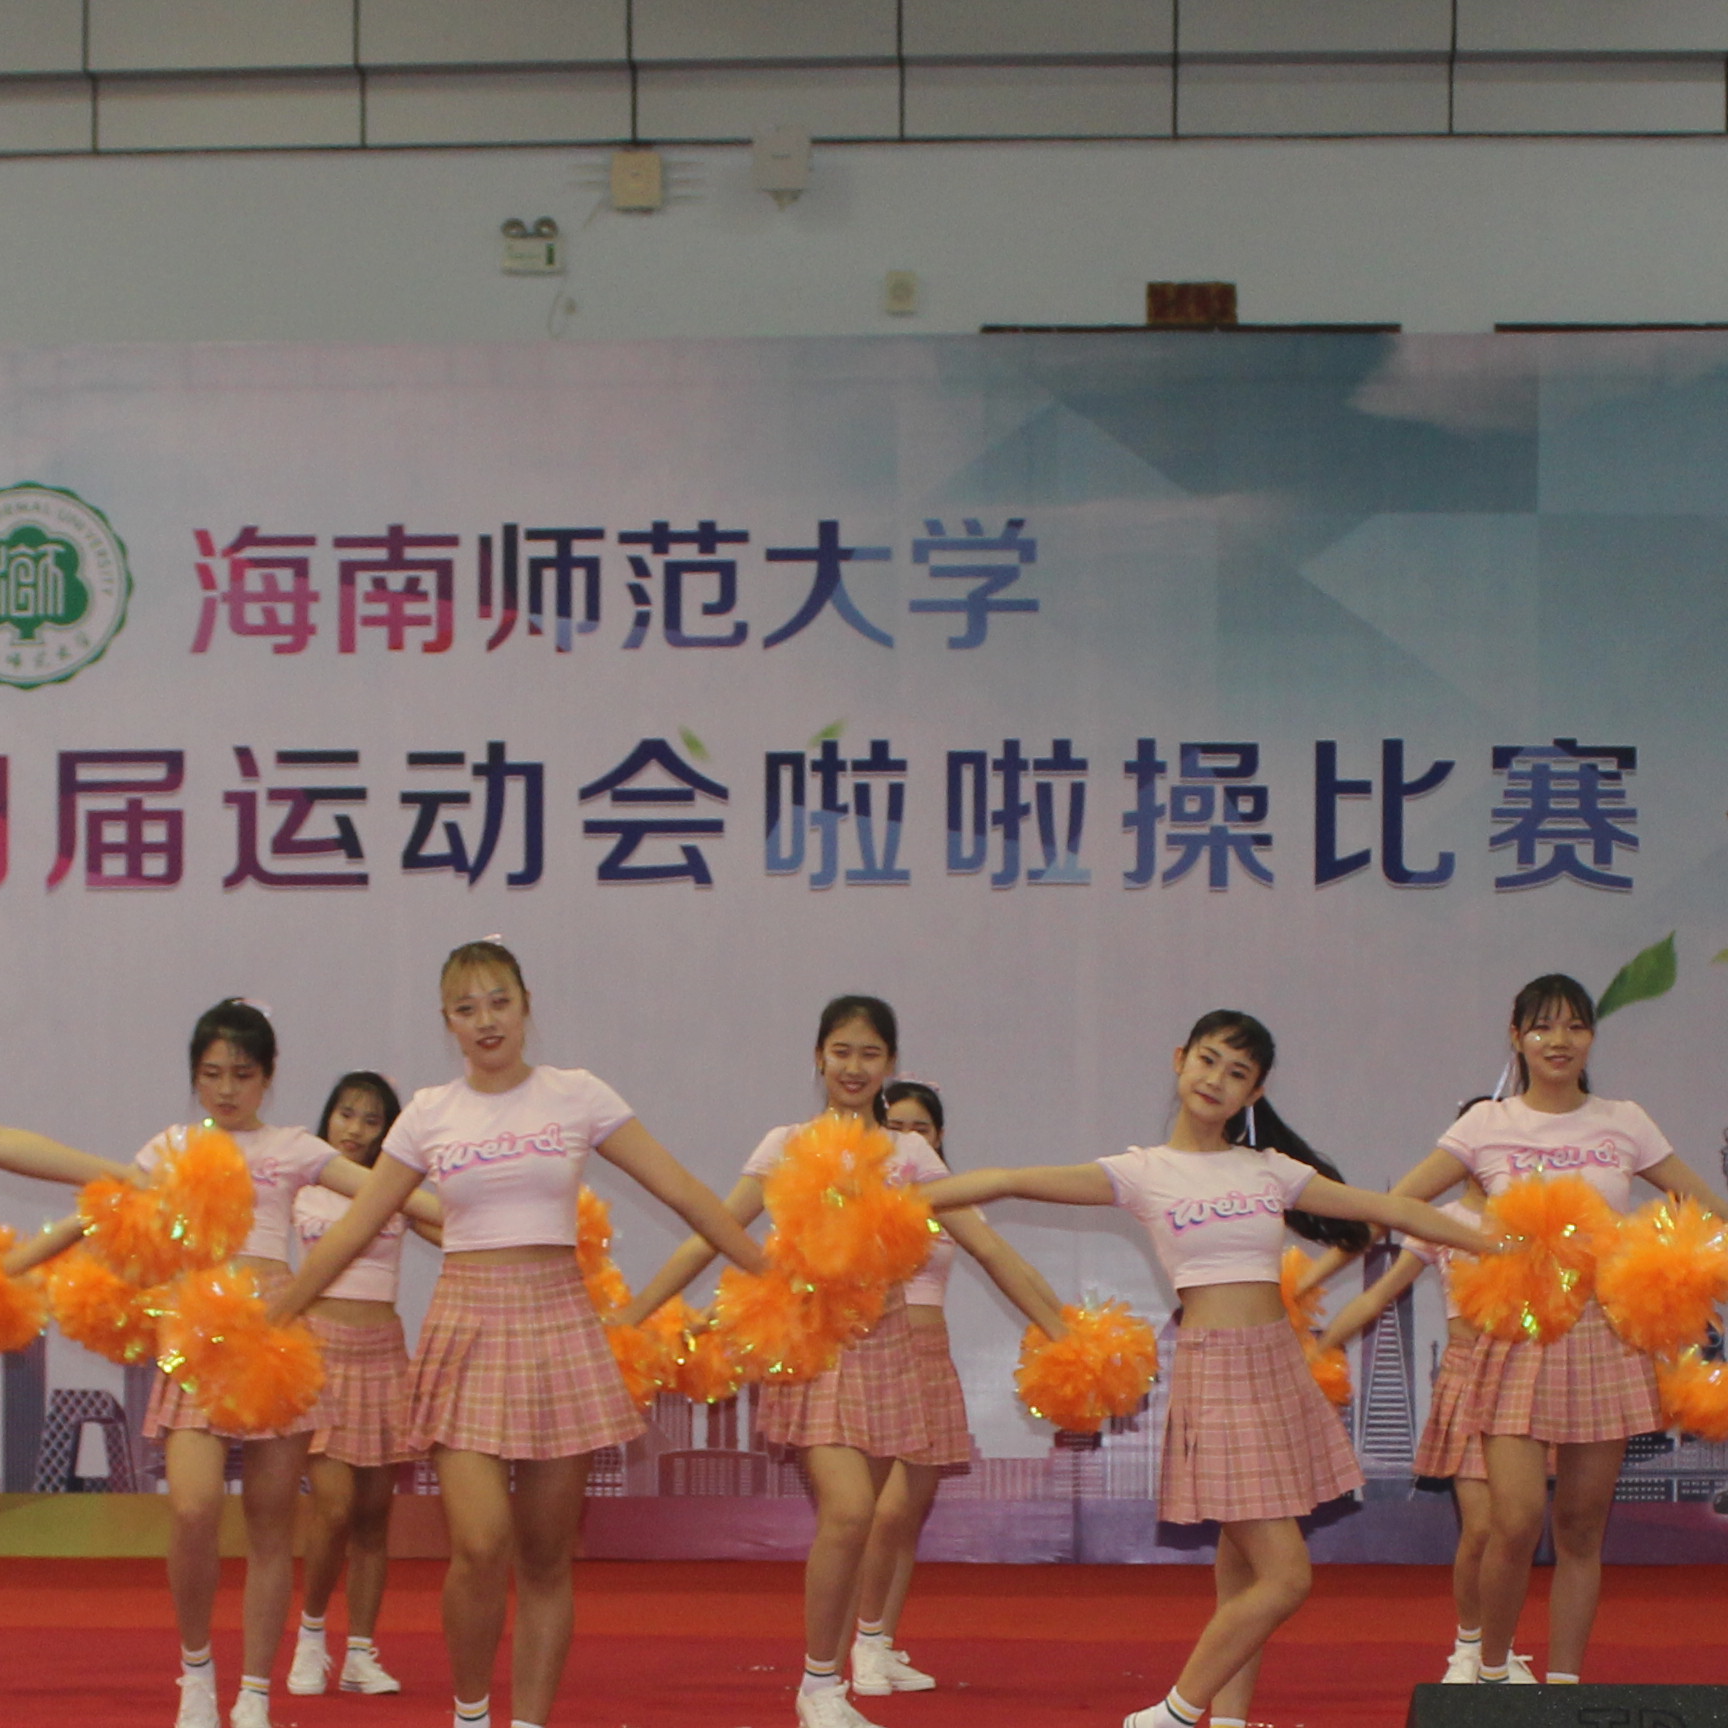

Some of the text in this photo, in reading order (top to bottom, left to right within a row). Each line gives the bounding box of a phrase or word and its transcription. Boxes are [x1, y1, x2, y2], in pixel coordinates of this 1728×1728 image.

[189, 517, 1041, 656] 海南师范大学
